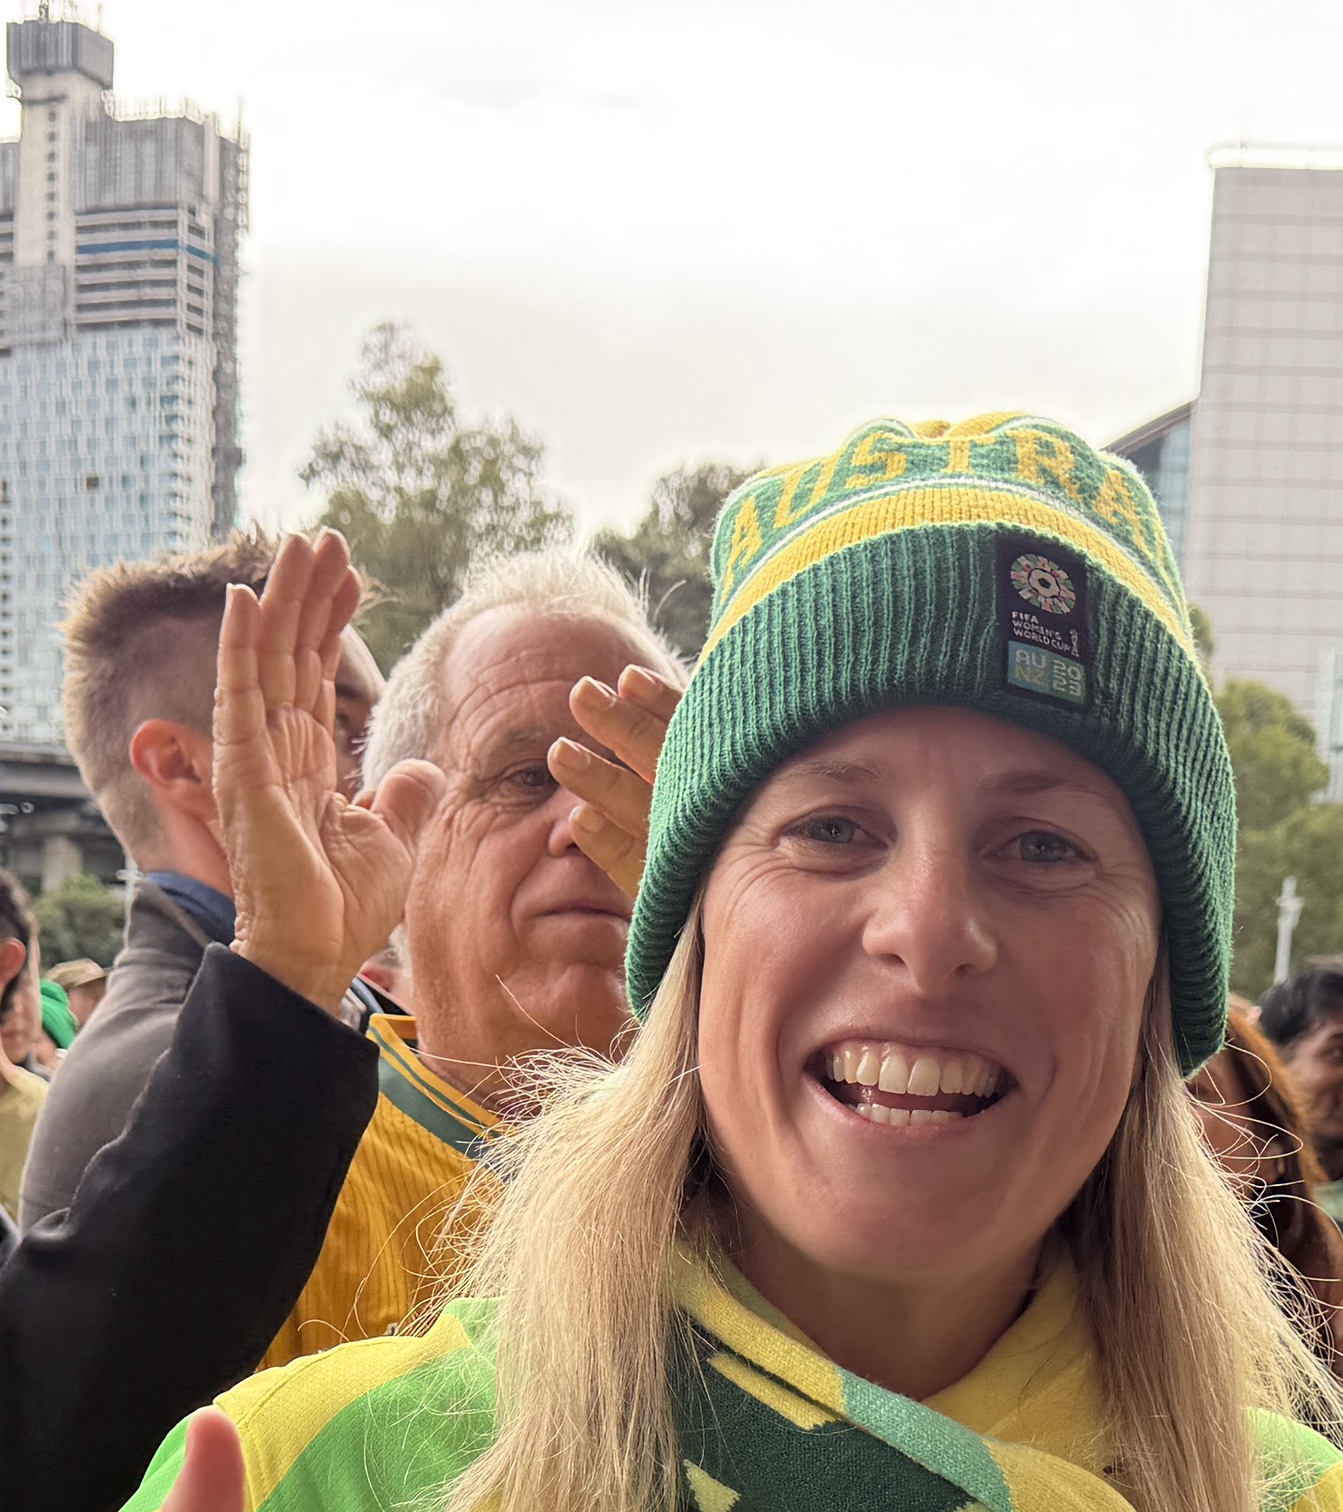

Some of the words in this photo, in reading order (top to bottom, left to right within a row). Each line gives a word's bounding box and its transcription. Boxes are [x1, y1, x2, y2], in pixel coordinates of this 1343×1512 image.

[1012, 611, 1039, 624] FIFA
[1013, 628, 1050, 645] WORLD
[1051, 639, 1072, 653] CUP
[1016, 649, 1047, 669] AU
